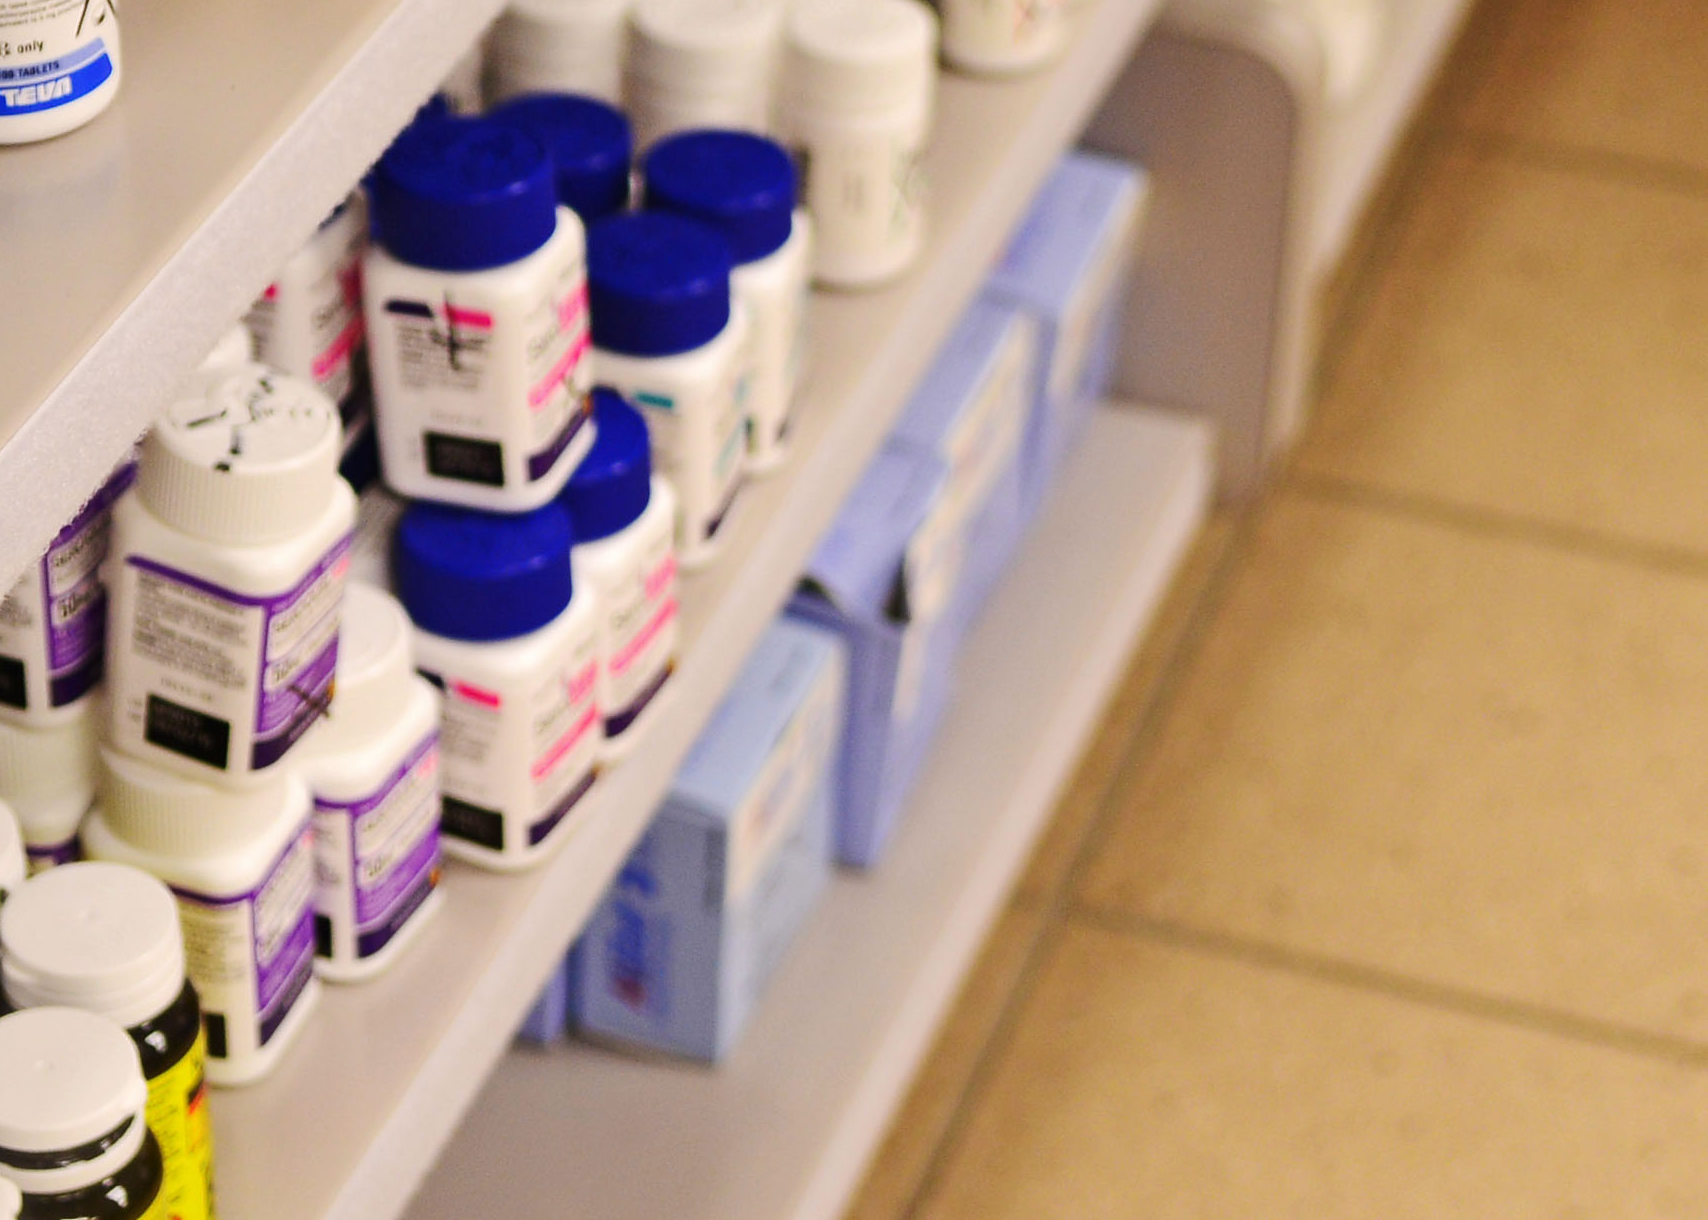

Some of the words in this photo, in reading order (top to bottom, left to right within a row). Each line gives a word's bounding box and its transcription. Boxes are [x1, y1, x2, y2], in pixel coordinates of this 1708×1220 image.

[17, 40, 44, 55] only
[18, 59, 60, 78] TABLETS
[0, 74, 73, 108] TEVA
